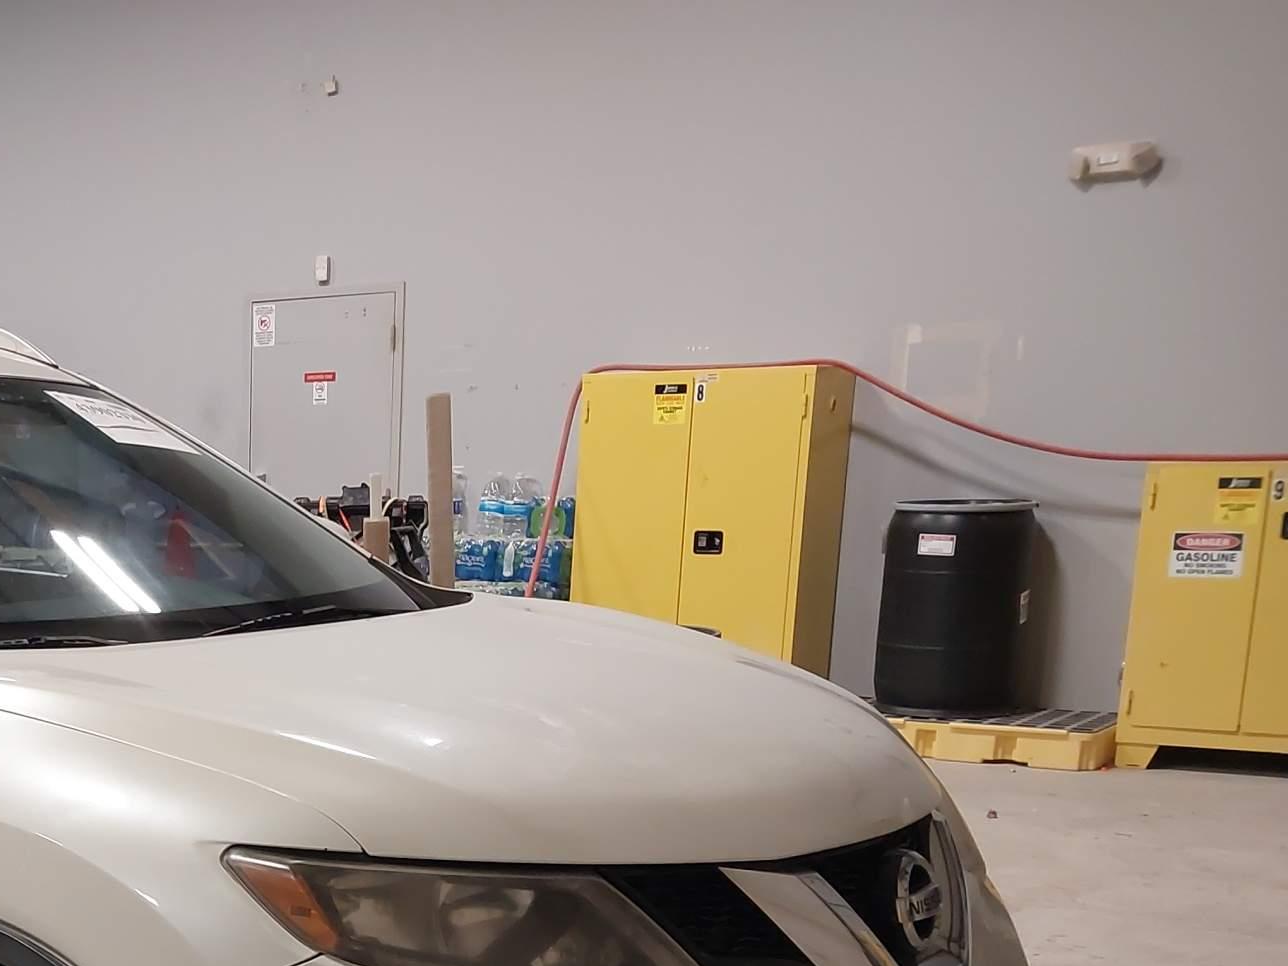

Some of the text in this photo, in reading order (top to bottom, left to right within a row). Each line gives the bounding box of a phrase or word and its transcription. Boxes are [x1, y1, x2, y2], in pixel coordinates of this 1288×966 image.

[697, 384, 704, 401] 8
[1274, 480, 1285, 500] 9
[1186, 537, 1231, 547] DANGER
[1175, 552, 1238, 562] GASOLINE
